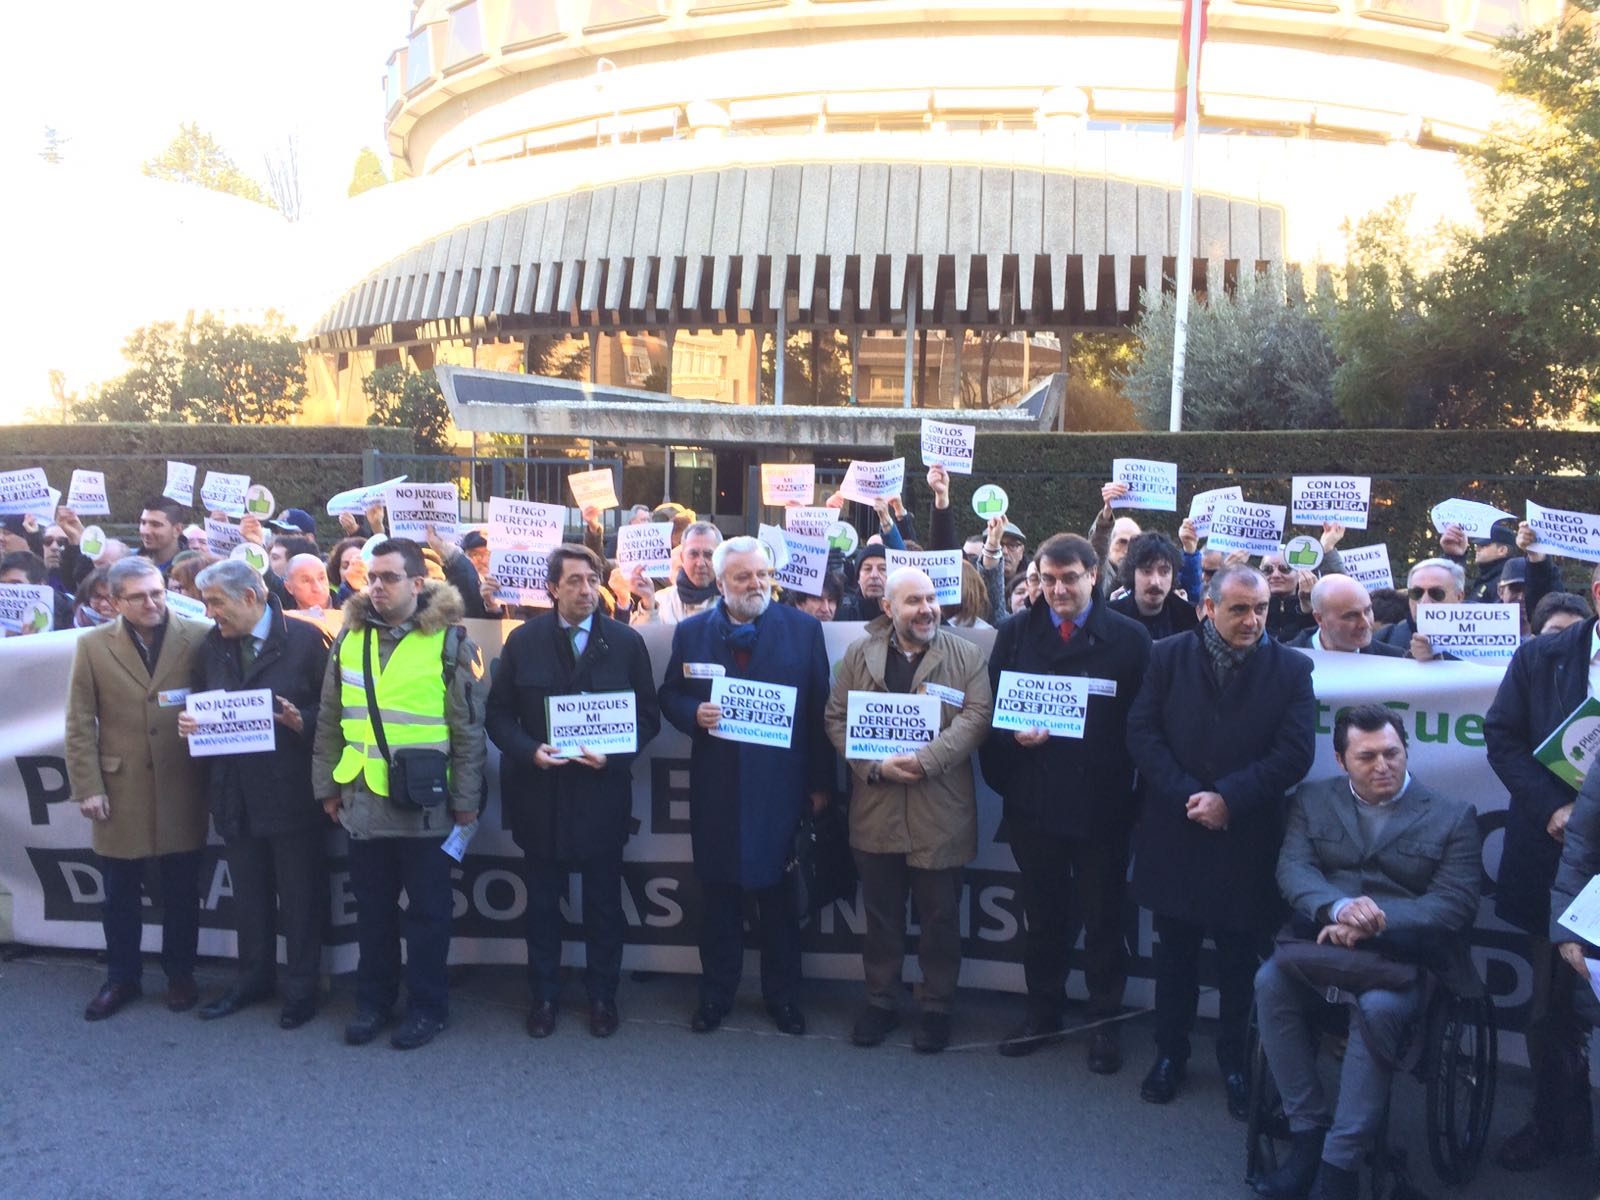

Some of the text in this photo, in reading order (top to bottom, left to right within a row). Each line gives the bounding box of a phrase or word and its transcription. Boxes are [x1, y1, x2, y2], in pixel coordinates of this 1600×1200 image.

[928, 425, 963, 436] CON LOS
[925, 434, 967, 447] DERECHOS
[941, 446, 971, 457] JUEGA
[1124, 463, 1146, 472] CON
[1119, 473, 1170, 484] DERECHOS
[1307, 481, 1356, 490] CON LOS
[396, 489, 453, 500] NO JUZGUES
[1301, 491, 1361, 500] DERECHOS
[422, 501, 434, 509] MI
[508, 504, 546, 517] TENGO
[1296, 501, 1365, 512] NO SE JUEGA
[393, 512, 457, 523] DISCAPACIDAD
[1226, 505, 1271, 518] CON LOS
[494, 514, 558, 529] DERECHO A
[1219, 514, 1276, 529] DERECHOS
[1296, 513, 1365, 523] #MiVotoCuenta
[1541, 512, 1584, 525] TENGO
[505, 526, 544, 538] VOTAR
[1212, 523, 1279, 540] NO SE JUEGA
[1530, 518, 1588, 535] DERECHO
[626, 528, 660, 539] CON LOS
[1545, 531, 1588, 545] VOTAR
[623, 538, 665, 549] DERECHOS
[504, 553, 529, 564] CON
[891, 555, 955, 567] NO JUZGUES
[511, 577, 525, 588] SE
[21, 590, 40, 599] LOS
[1425, 610, 1510, 622] NO JUZGUES
[1459, 623, 1476, 632] MI
[1017, 679, 1072, 692] CON LOS
[728, 684, 781, 700] CON LOS
[1008, 689, 1078, 705] DERECHOS
[195, 696, 265, 712] NO JUZGUES
[557, 699, 629, 714] NO JUZGUES
[721, 695, 786, 713] DERECHOS
[865, 703, 921, 715] CON LOS
[1001, 700, 1082, 718] NO SE JUEGA
[221, 711, 237, 721] MI
[586, 713, 601, 723] MI
[735, 709, 752, 722] SE
[752, 711, 790, 727] JUEGA
[858, 715, 927, 728] DERECHOS
[998, 714, 1081, 732] #MiVotoCuenta
[554, 723, 633, 737] DISCAPACIDAD
[853, 728, 931, 741] NO SE JUEGA
